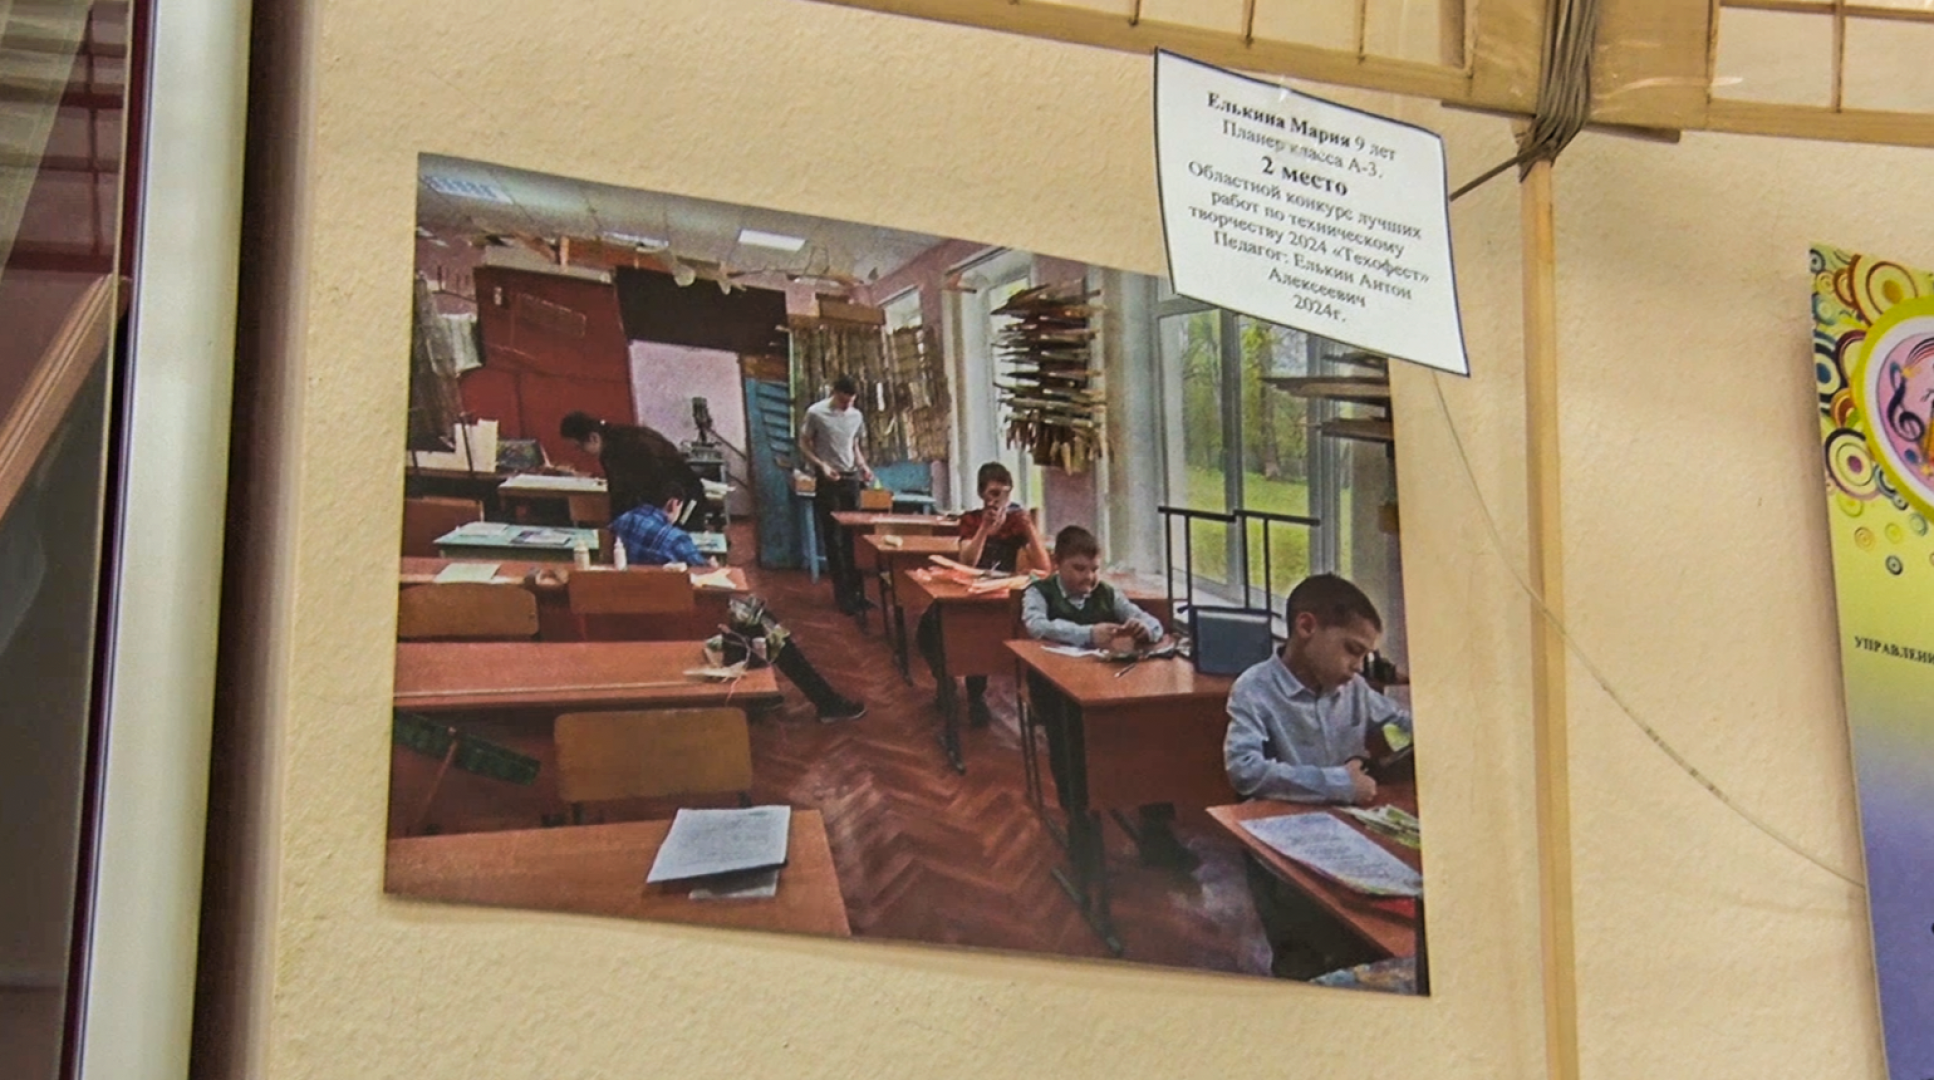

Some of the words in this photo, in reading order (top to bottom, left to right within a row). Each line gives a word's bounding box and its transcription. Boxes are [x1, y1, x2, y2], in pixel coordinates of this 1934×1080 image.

[1207, 91, 1286, 129] Елькина
[1290, 117, 1351, 147] Мария
[1354, 135, 1366, 151] 9
[1369, 143, 1396, 161] лет
[1222, 118, 1286, 153] Планер
[1290, 143, 1343, 168] класса
[1188, 160, 1281, 200] Областной
[1286, 191, 1354, 222] конкурс
[1358, 212, 1422, 240] лучших
[1261, 155, 1274, 176] 2
[1281, 166, 1348, 196] место
[1188, 205, 1284, 244] творчеству
[1288, 230, 1327, 255] 2024
[1211, 191, 1259, 214] работ
[1265, 206, 1285, 222] по
[1288, 214, 1405, 259] техническому
[1213, 230, 1289, 265] Педагог:
[1294, 253, 1354, 284] Елькин
[1359, 273, 1412, 300] Антон
[1268, 266, 1366, 307] Алексеевич
[1292, 294, 1347, 322] 2024г.
